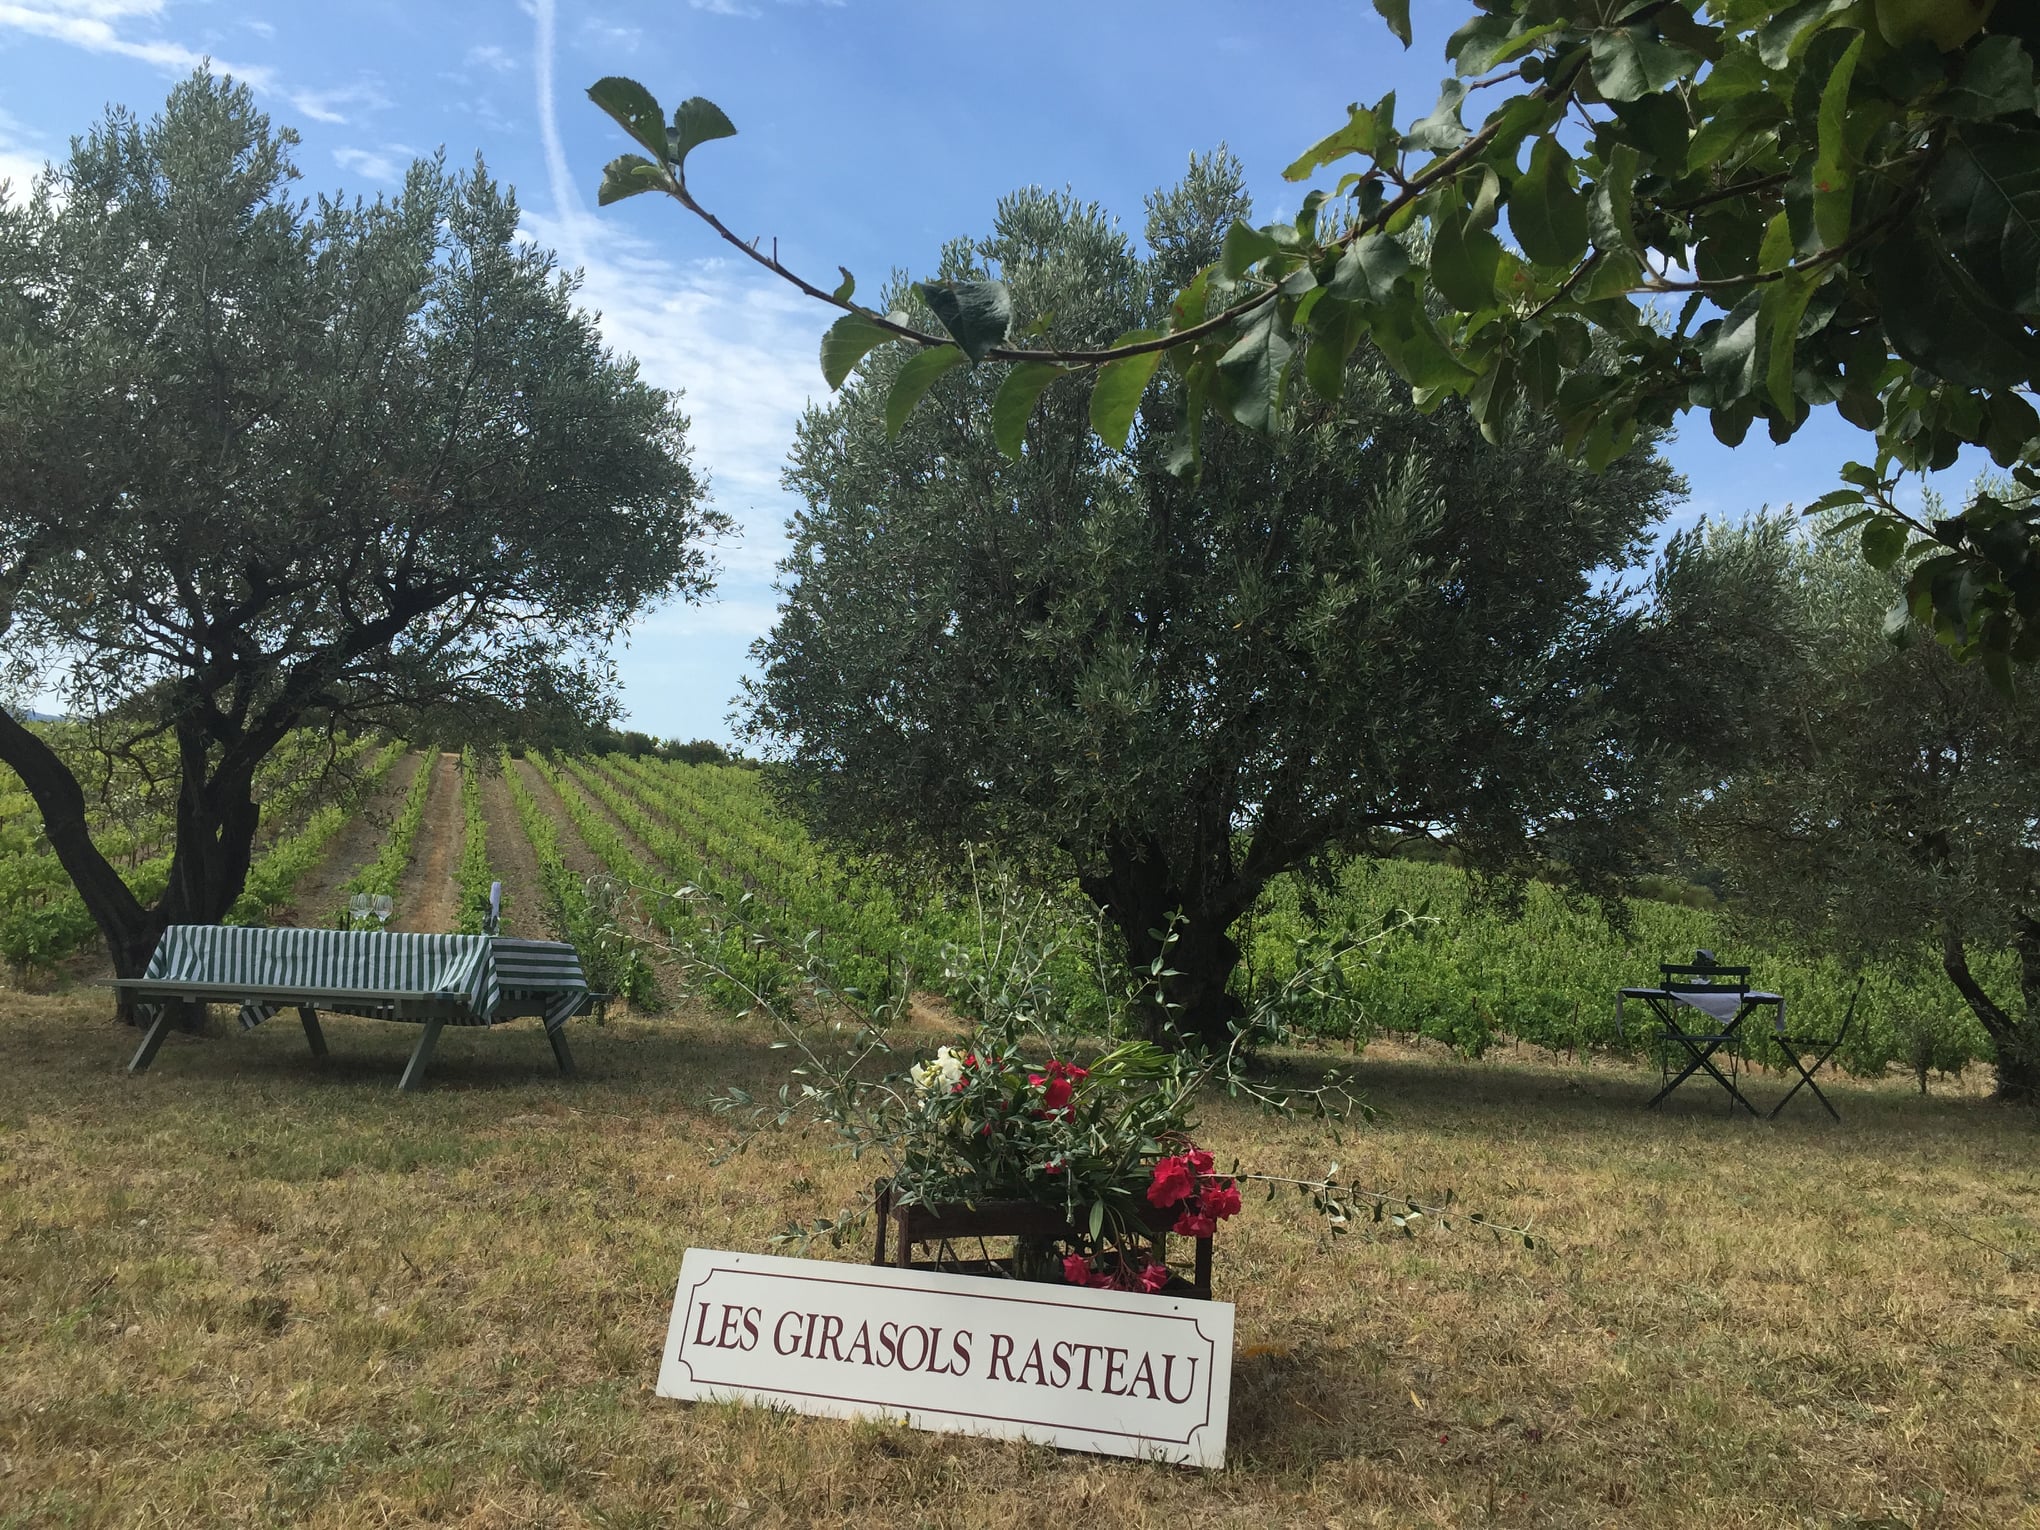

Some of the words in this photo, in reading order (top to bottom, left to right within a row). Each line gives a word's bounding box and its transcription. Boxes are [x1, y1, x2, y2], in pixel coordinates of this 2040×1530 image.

[692, 1301, 762, 1352] LES
[773, 1310, 973, 1377] GIRASOLS
[986, 1333, 1199, 1405] RASTEAU
